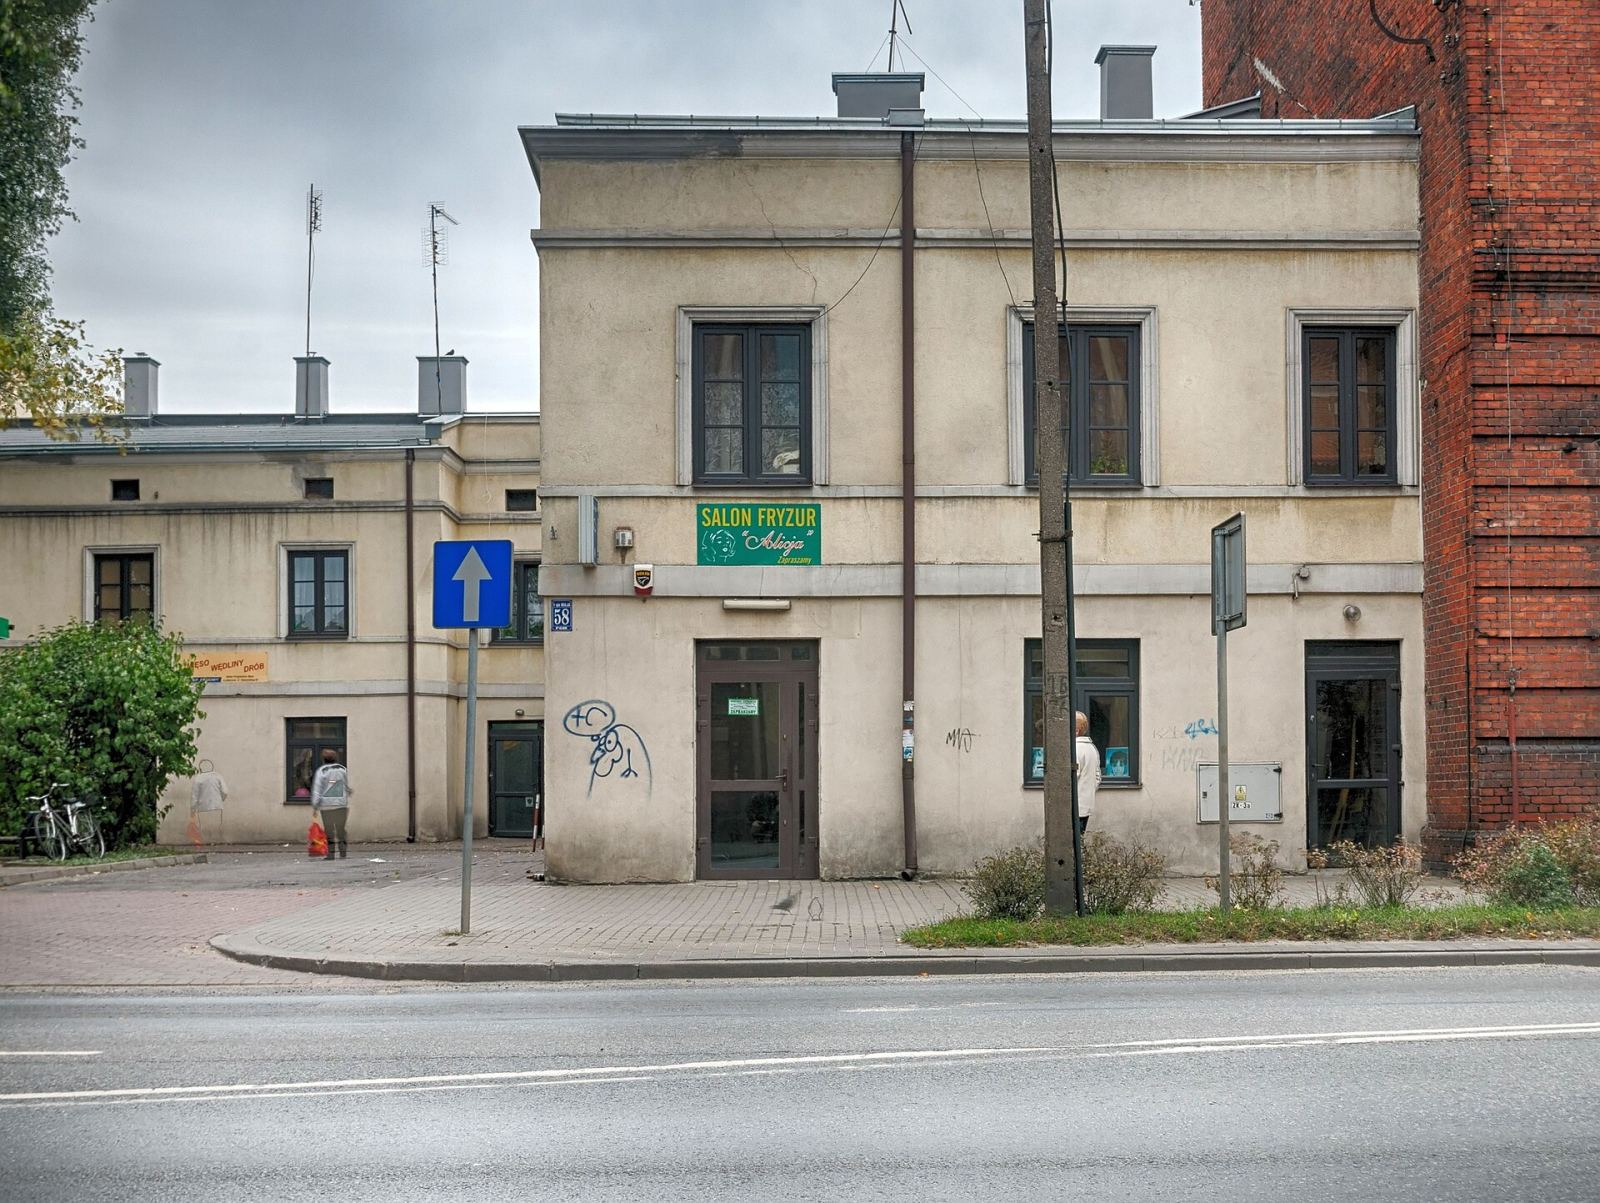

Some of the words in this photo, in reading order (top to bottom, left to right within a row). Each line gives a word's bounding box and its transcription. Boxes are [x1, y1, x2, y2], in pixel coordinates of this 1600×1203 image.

[701, 507, 751, 527] SALON
[757, 507, 816, 527] FRYZUR
[554, 608, 570, 625] 58
[210, 659, 244, 672] WĘDLINY
[243, 662, 265, 673] DRÓB
